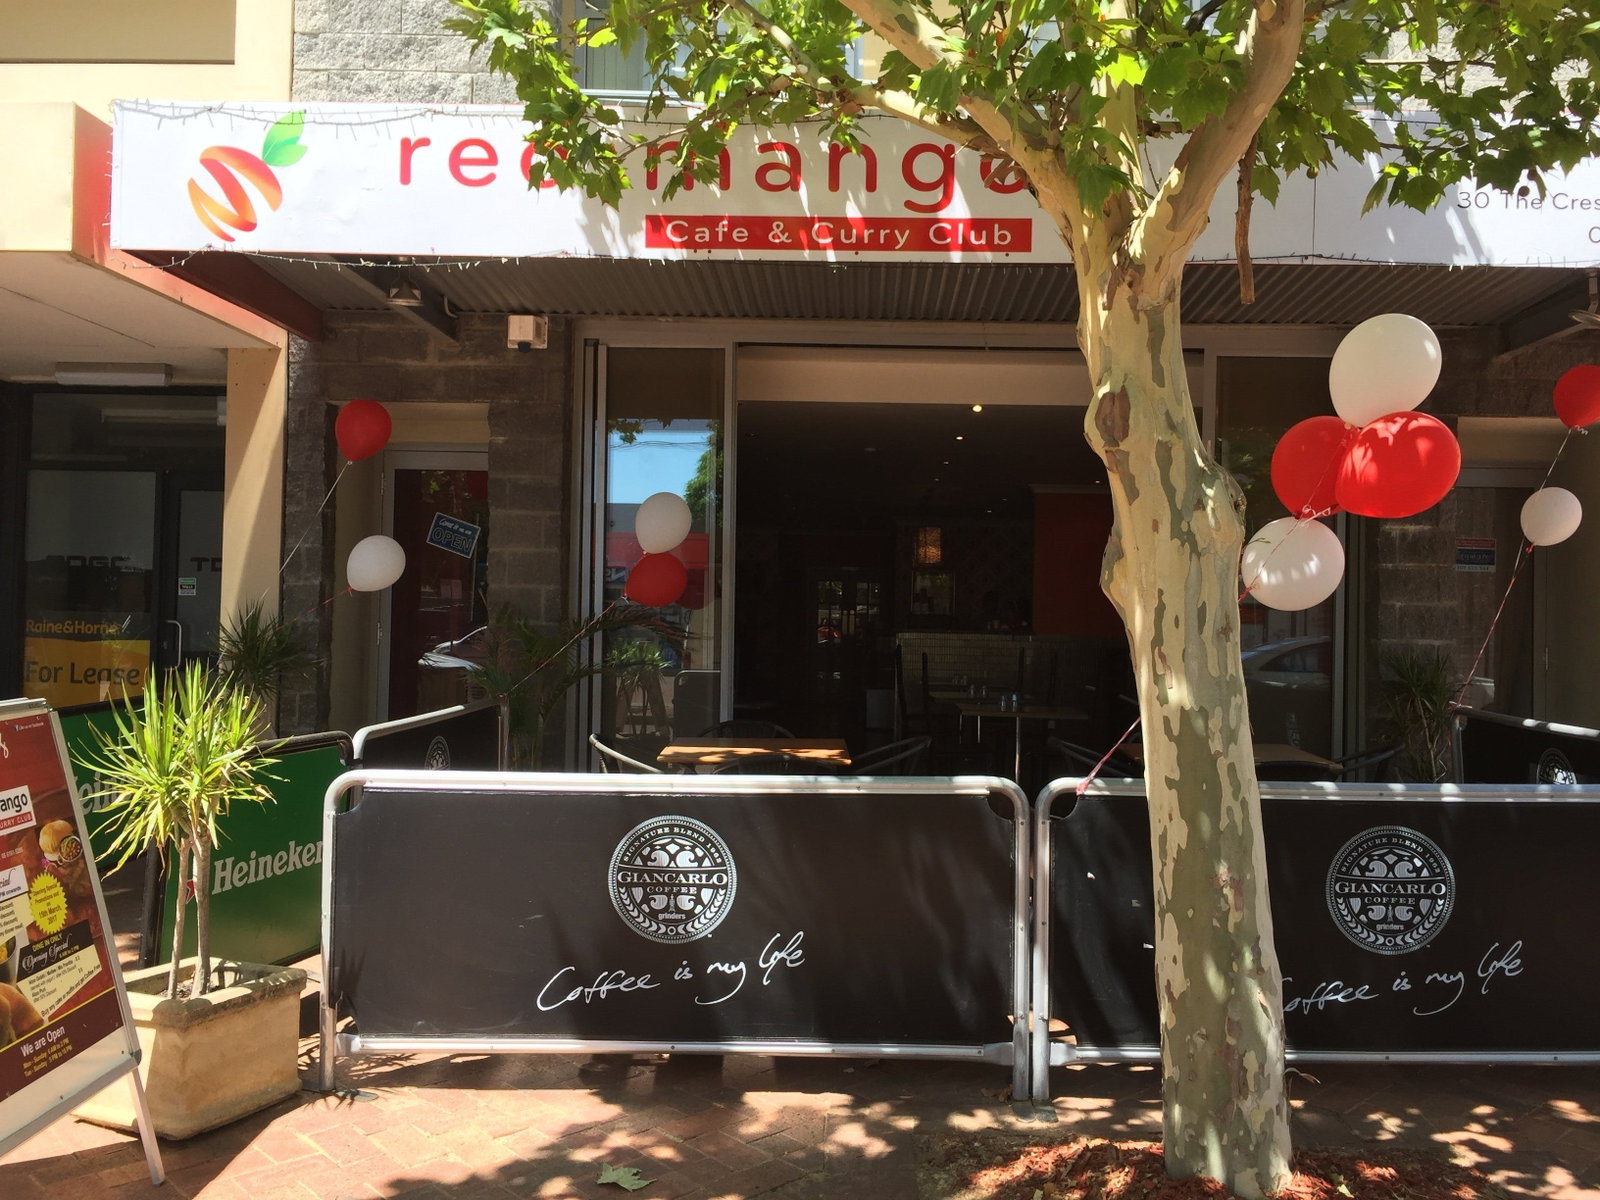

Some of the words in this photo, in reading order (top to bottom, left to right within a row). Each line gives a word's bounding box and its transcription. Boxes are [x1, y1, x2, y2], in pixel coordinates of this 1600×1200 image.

[1457, 192, 1489, 209] 30
[1501, 190, 1543, 209] The
[665, 219, 750, 245] Cafe
[768, 221, 792, 244] &
[810, 221, 911, 250] Curry
[928, 223, 1012, 246] Club
[431, 527, 474, 553] OPEN
[25, 661, 63, 683] For
[70, 662, 140, 686] Lease
[0, 793, 28, 813] ango
[17, 813, 32, 824] CLUB
[623, 826, 670, 863] SIGNATURE
[673, 826, 706, 843] BLEND
[706, 842, 722, 864] 1962
[1341, 837, 1388, 873] SIGNATURE
[1391, 837, 1424, 853] BLEND
[617, 870, 728, 886] GIANCARLO
[646, 886, 698, 894] COFFEE
[1335, 881, 1447, 896] GIANCARLO
[48, 904, 62, 914] March
[1364, 896, 1416, 905] COFFEE
[47, 915, 57, 925] 2017
[658, 911, 686, 920] grinders
[1375, 923, 1405, 931] grinders
[32, 943, 45, 952] DINE
[50, 933, 63, 944] ONLY
[22, 951, 48, 974] Opening
[48, 933, 73, 963] Special
[40, 1008, 49, 1017] Buy
[84, 969, 94, 980] Coffee
[536, 965, 661, 1012] Coffee
[673, 960, 694, 981] is
[694, 960, 747, 1006] my
[1392, 971, 1412, 991] is
[1413, 971, 1466, 1016] my
[20, 1043, 34, 1058] We
[34, 1037, 47, 1051] are
[46, 1026, 66, 1042] Open
